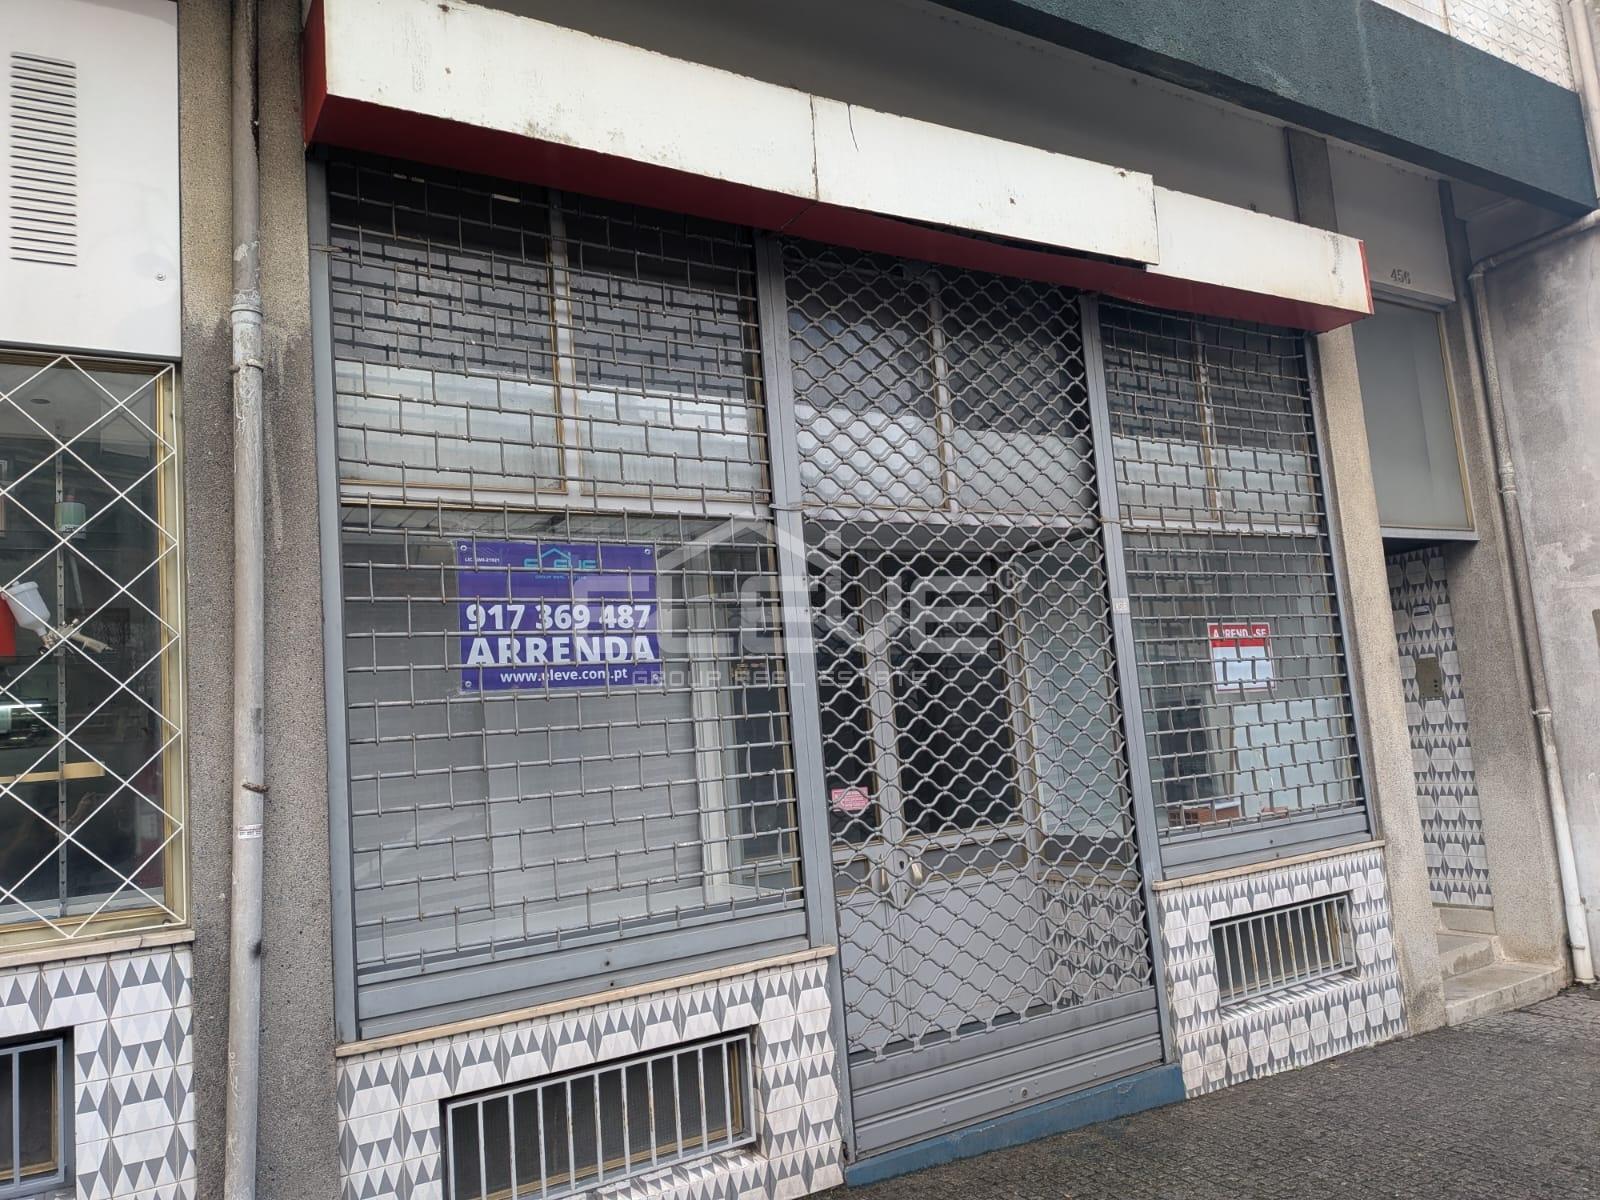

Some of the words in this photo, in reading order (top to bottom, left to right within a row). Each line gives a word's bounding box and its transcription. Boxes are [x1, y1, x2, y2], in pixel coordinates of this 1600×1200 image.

[466, 604, 526, 630] 917
[535, 604, 591, 630] 369
[599, 604, 651, 629] 487
[467, 635, 656, 666] ARRENDA
